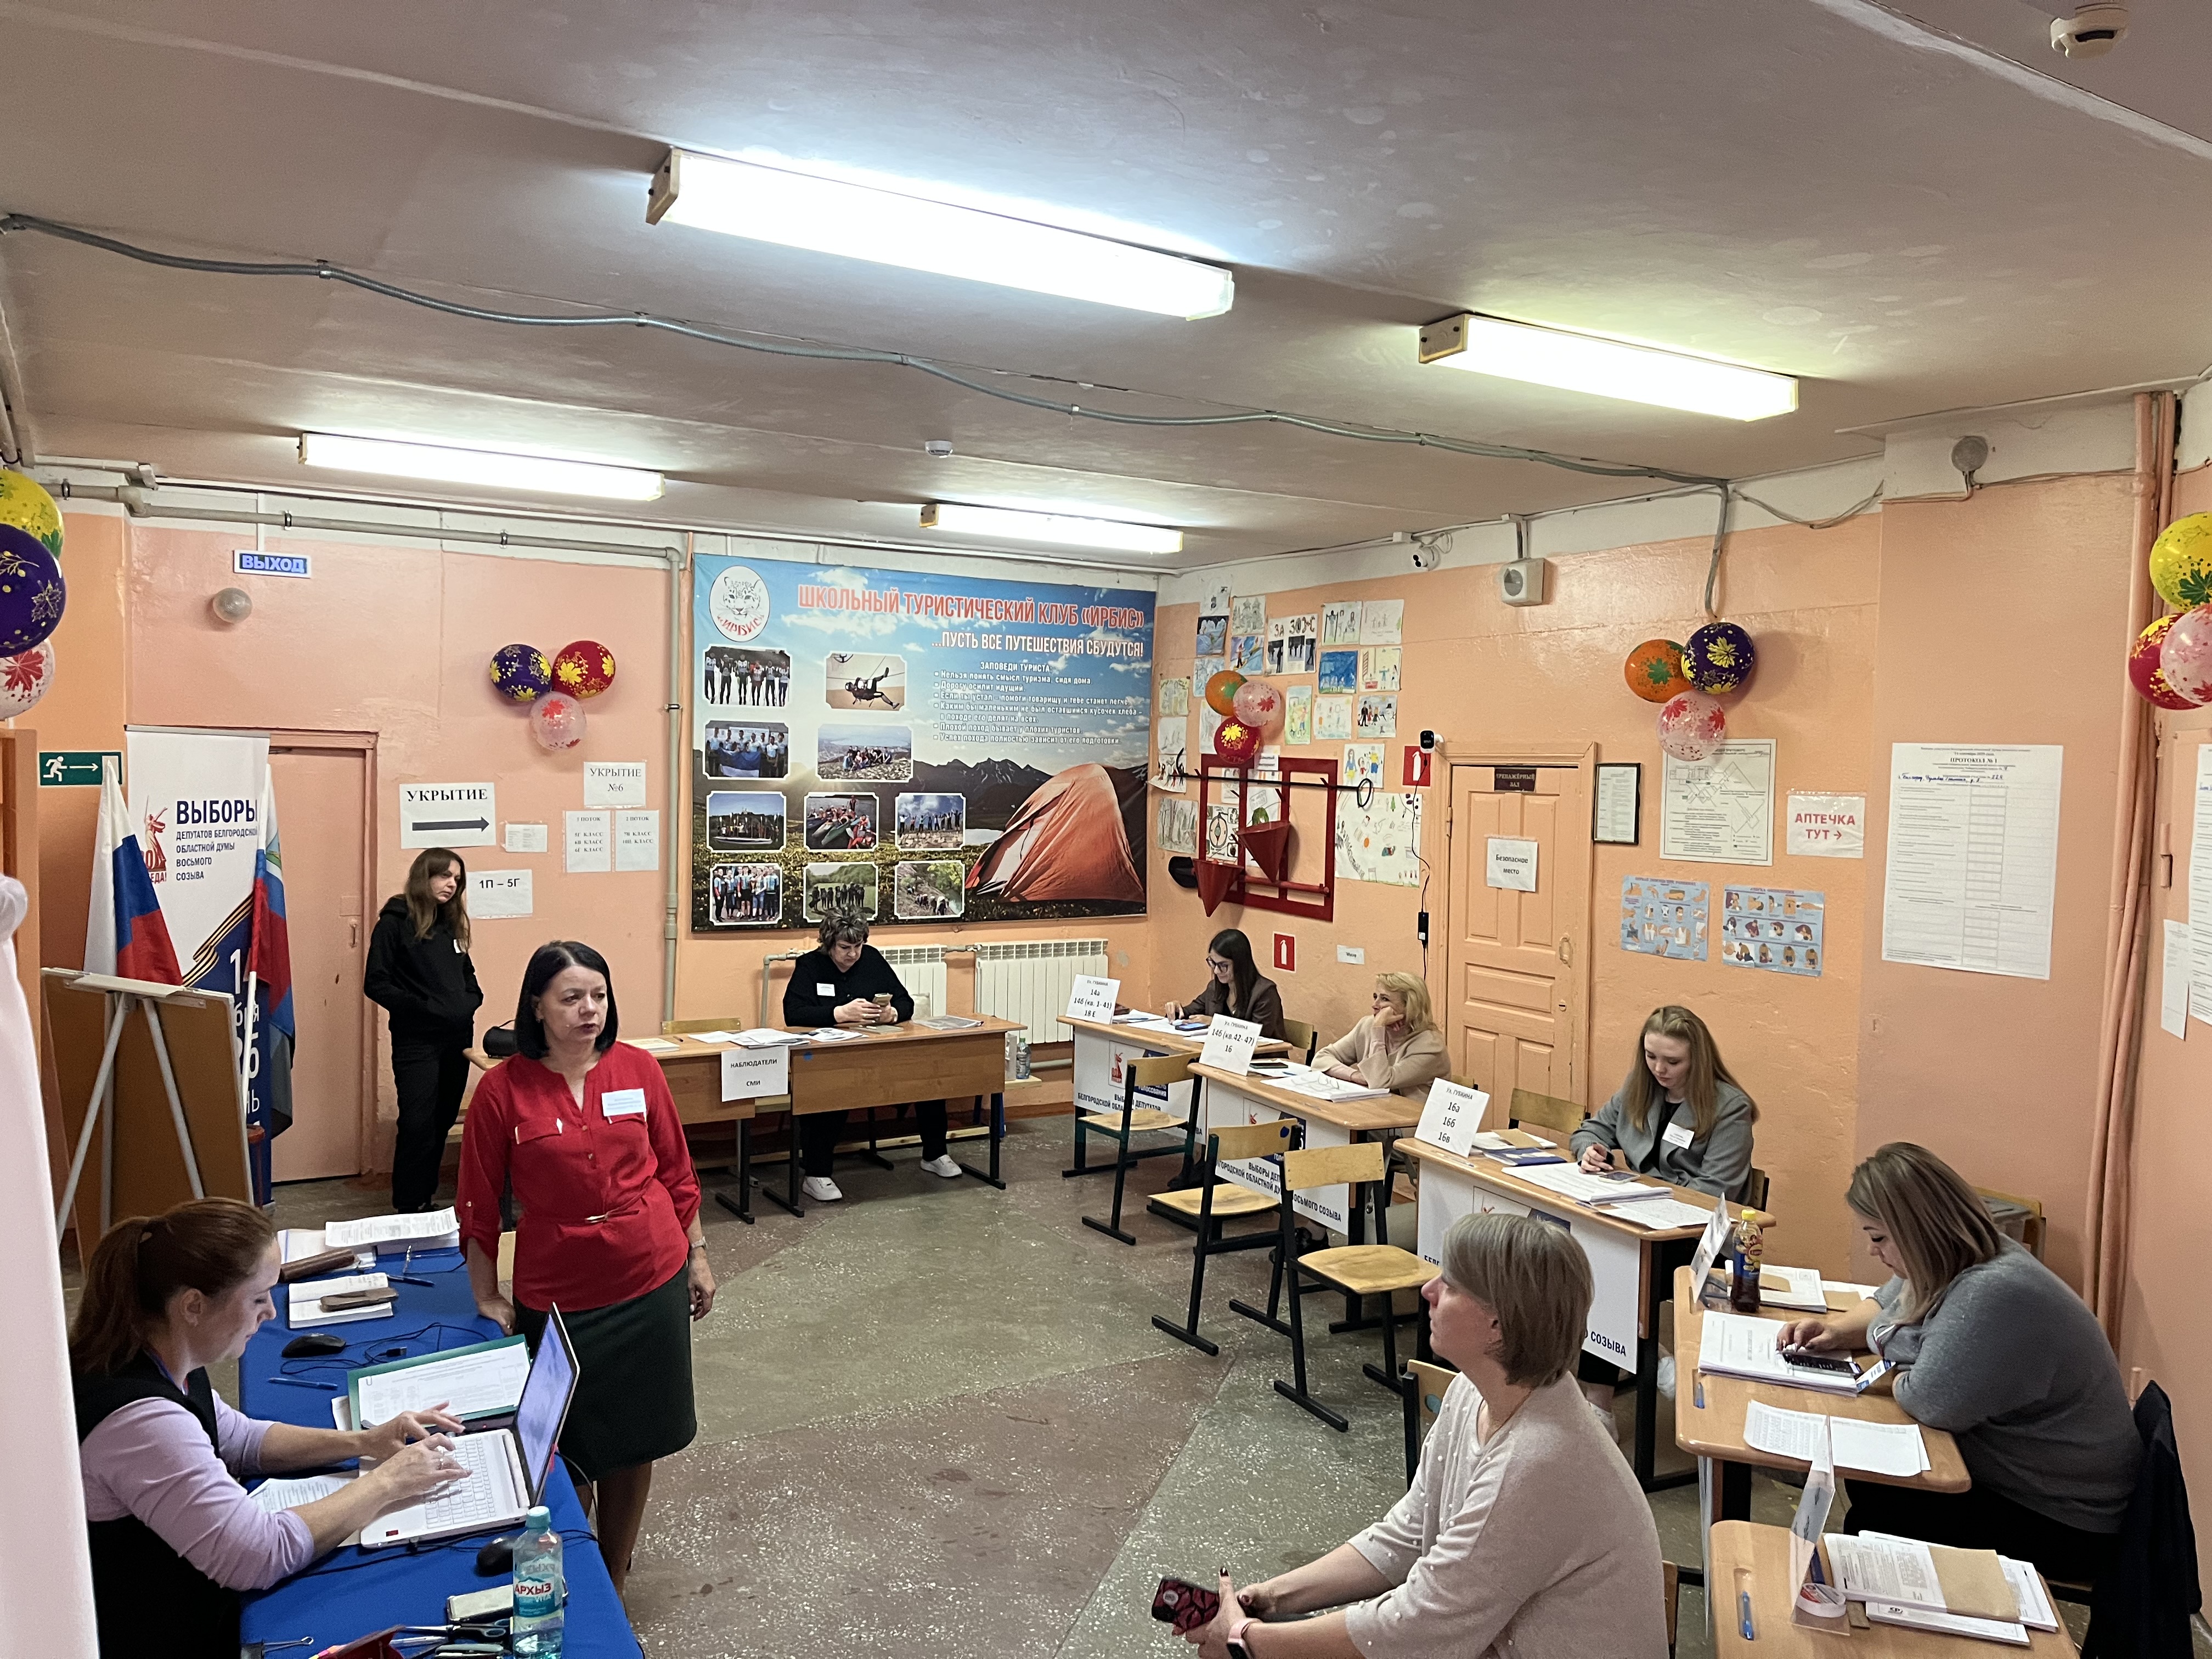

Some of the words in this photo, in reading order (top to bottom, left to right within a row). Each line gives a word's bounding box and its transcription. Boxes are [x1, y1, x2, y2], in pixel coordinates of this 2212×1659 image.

[242, 555, 305, 573] ВЫХОД
[799, 585, 900, 614] ШКОЛЬНЫЙ
[904, 594, 1035, 623] ТУРИСТИЧЕСКИЙ
[1038, 602, 1078, 626] КЛУБ
[1081, 606, 1144, 629] «ИРБИС»
[932, 631, 979, 648] ...ПУСТЬ
[981, 634, 1002, 650] ВСЕ
[1005, 635, 1084, 655] ПУТЕШЕСТВИЯ
[1086, 640, 1144, 658] СБУДУТСЯ!
[980, 662, 1018, 672] ЗАПОВЕДИ
[1020, 663, 1052, 673] ТУРИСТА:
[941, 670, 967, 679] Нельзя
[969, 672, 994, 680] понять
[940, 680, 967, 691] Дорогу
[940, 691, 958, 699] Если
[972, 693, 992, 702] устал
[1001, 695, 1026, 703] помоги
[1028, 696, 1061, 705] товарищу
[940, 702, 964, 710] Каким
[966, 702, 977, 710] бы
[979, 704, 1019, 712] маленьким
[1090, 707, 1116, 716] кусочек
[946, 713, 972, 721] походе
[988, 715, 1009, 723] делят
[940, 722, 966, 731] Плохой
[968, 724, 990, 732] поход
[991, 723, 1017, 732] бывает
[939, 733, 961, 741] Успех
[1031, 736, 1058, 744] зависит
[590, 768, 641, 777] УКРЫТИЕ
[607, 783, 624, 792] №6
[406, 789, 488, 802] УКРЫТИЕ
[176, 799, 258, 824] ВЫБОРЫ
[1795, 813, 1855, 826] АПТЕЧКА
[176, 830, 212, 841] ДЕПУТАТОВ
[1805, 829, 1830, 840] ТУТ
[176, 842, 215, 854] ОБЛАСТНОЙ
[216, 842, 235, 853] ДУМЫ
[176, 857, 212, 867] ВОСЬМОГО
[1496, 854, 1528, 864] Безопасное
[176, 871, 204, 881] СОЗЫВА
[479, 879, 493, 889] 1П
[507, 878, 520, 887] 5Г
[730, 1059, 777, 1068] НАБЛЮДАТЕЛИ
[1453, 1089, 1473, 1100] ГУБКИНА
[1077, 1092, 1111, 1109] БЕЛГОРОДСКОЙ
[1447, 1102, 1460, 1113] 16а
[1438, 1131, 1451, 1143] 16в
[1248, 1162, 1270, 1179] ВЫБОРЫ
[1246, 1172, 1273, 1190] ОБЛАСТНОЙ
[1293, 1193, 1318, 1212] ОСЬМОГО
[1319, 1204, 1342, 1222] СОЗЫВА
[1590, 1330, 1626, 1357] СОЗЫВА
[515, 1582, 552, 1595] АРХЫЗ
